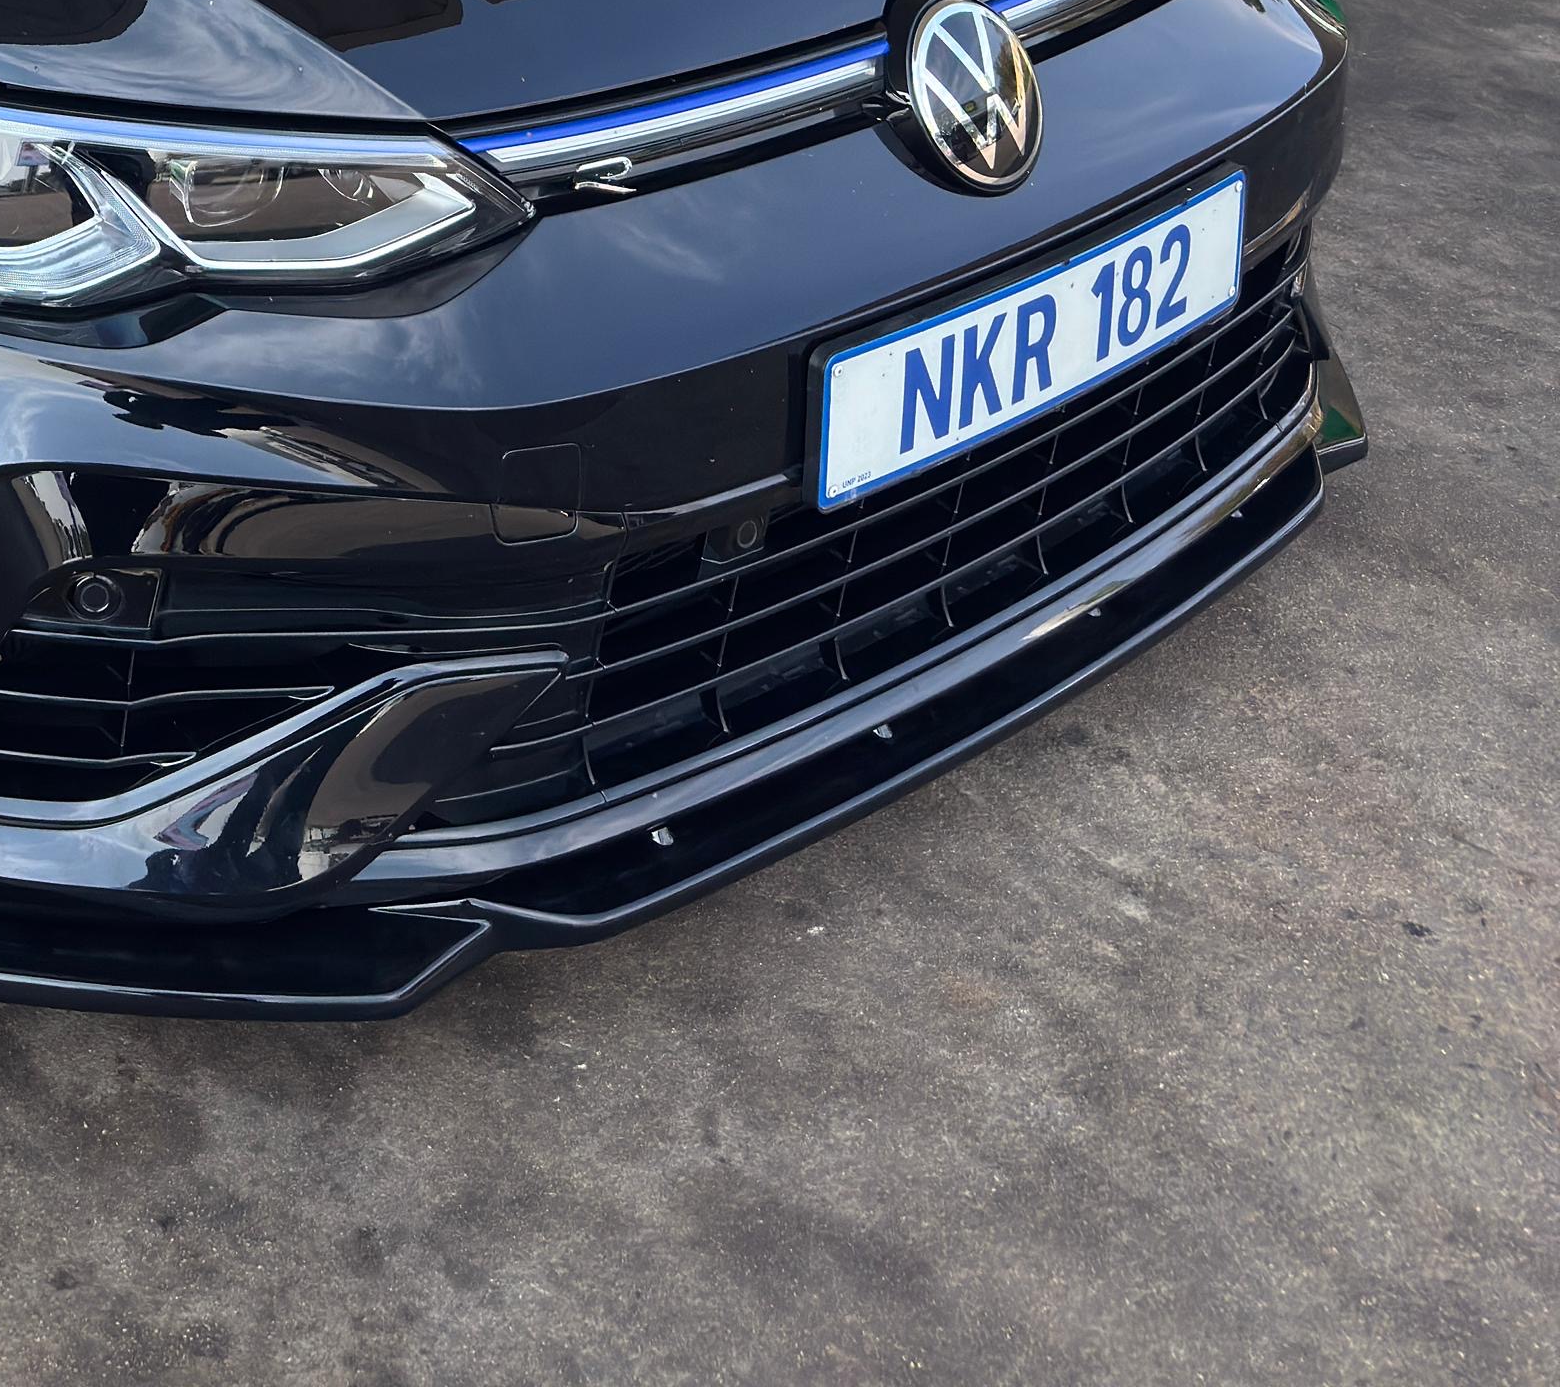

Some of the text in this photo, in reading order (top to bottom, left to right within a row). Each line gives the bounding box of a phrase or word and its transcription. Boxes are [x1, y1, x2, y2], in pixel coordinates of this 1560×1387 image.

[574, 156, 637, 194] R
[899, 223, 1192, 456] NKR 182
